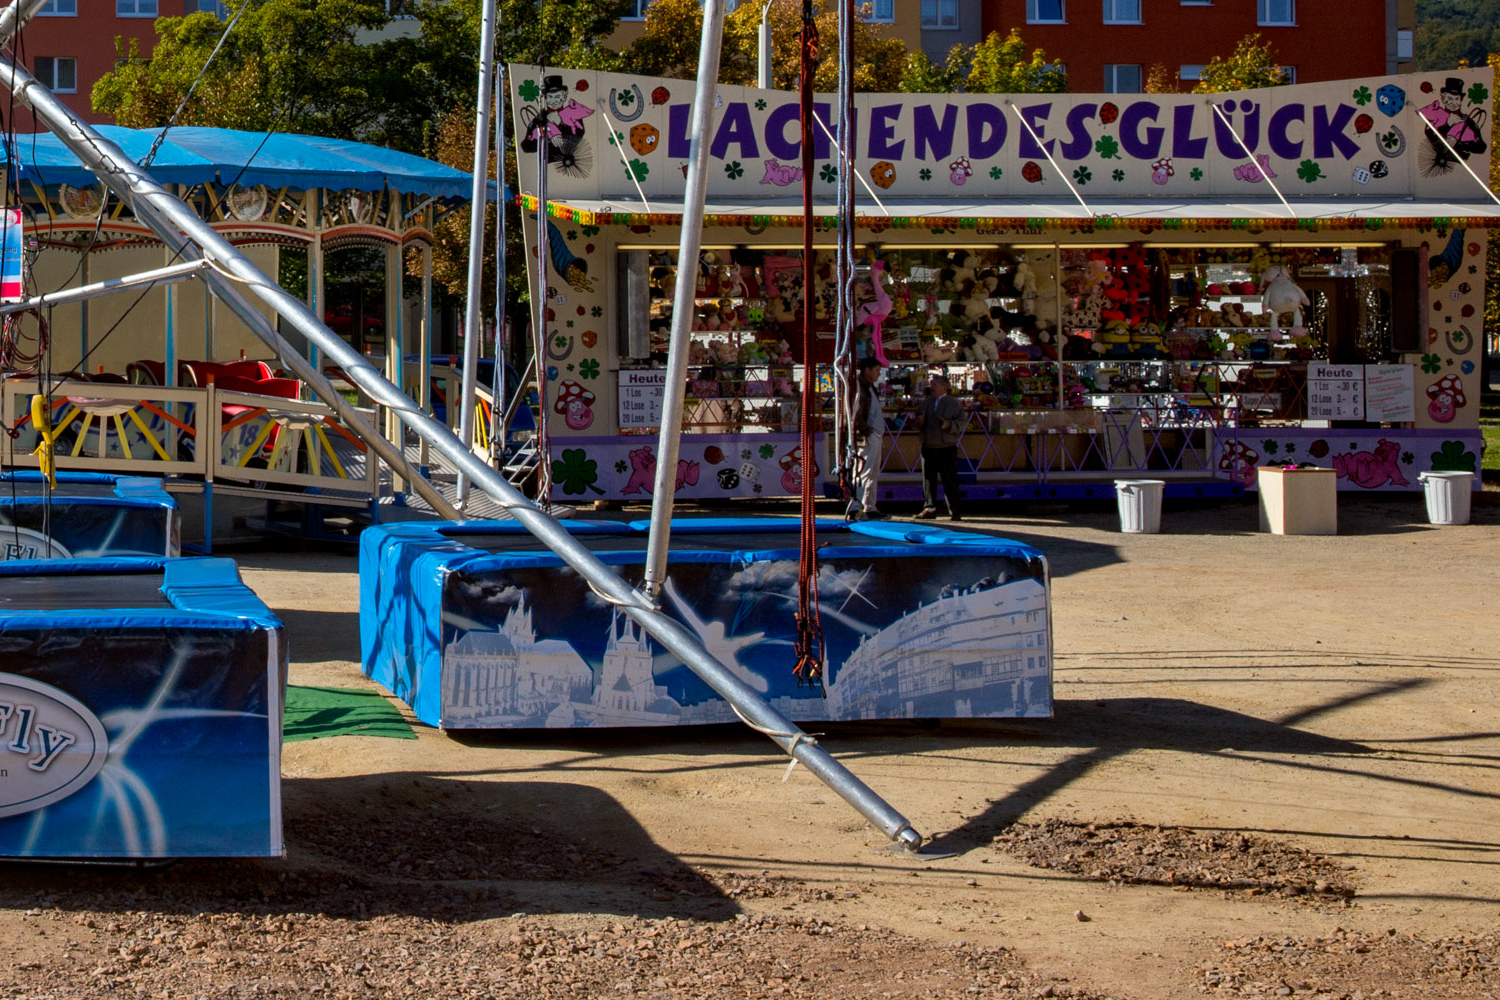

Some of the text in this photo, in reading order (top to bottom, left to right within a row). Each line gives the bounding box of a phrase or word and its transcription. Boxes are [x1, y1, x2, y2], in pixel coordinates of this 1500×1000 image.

[1317, 368, 1354, 378] Heute
[629, 374, 666, 384] Heute
[1319, 382, 1329, 391] Los
[631, 388, 642, 397] Los
[1311, 395, 1318, 404] 12
[1319, 395, 1332, 404] Lose
[622, 401, 630, 410] 12
[631, 401, 645, 410] Lose
[1319, 407, 1332, 416] Lose
[631, 414, 645, 423] Lose
[238, 423, 259, 447] 18
